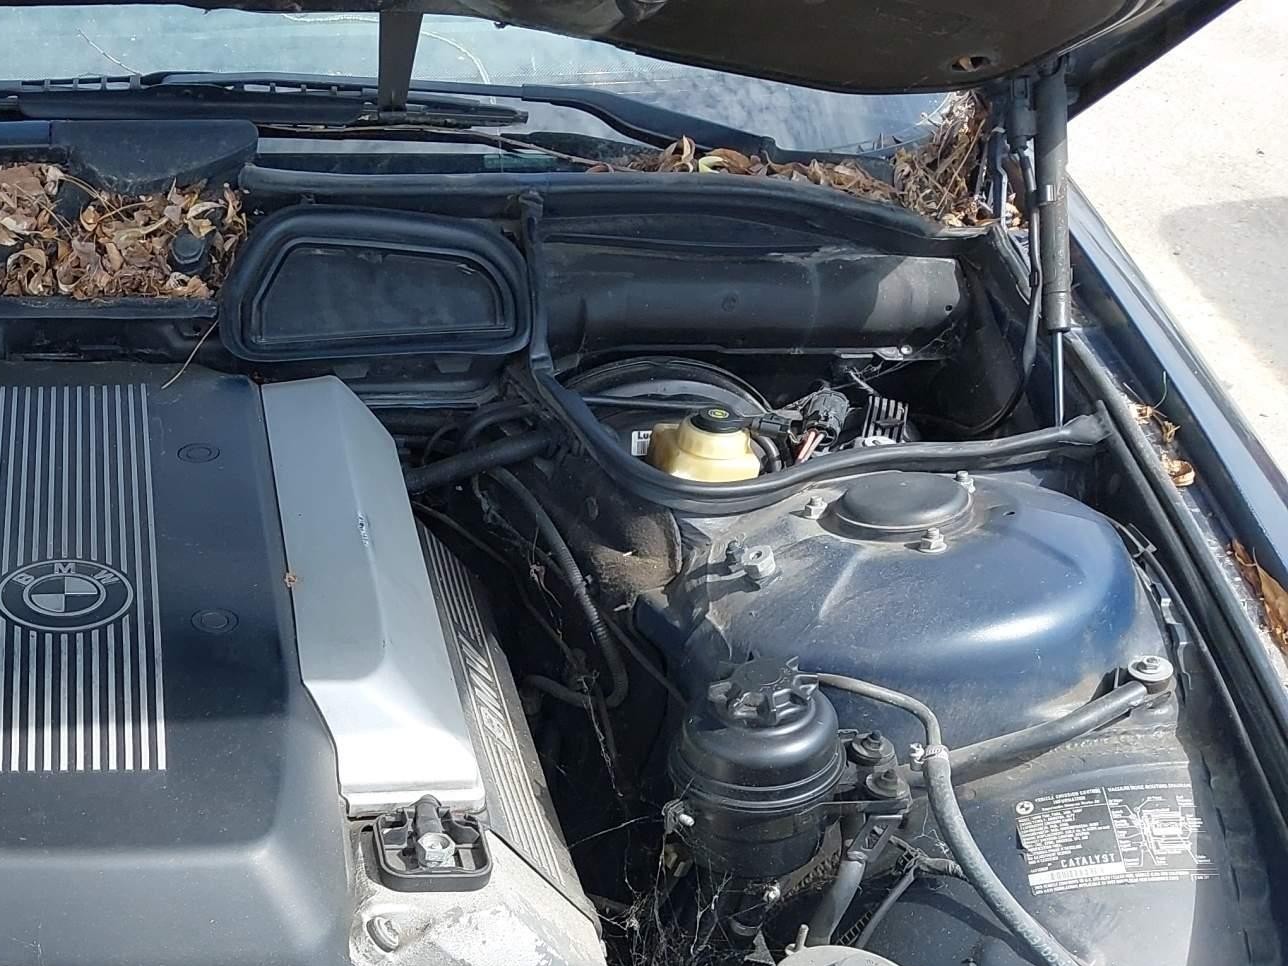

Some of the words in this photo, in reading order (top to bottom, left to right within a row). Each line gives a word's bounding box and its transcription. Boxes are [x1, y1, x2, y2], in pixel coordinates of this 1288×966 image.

[12, 563, 120, 585] BMW
[458, 631, 513, 752] BMW
[1061, 853, 1116, 868] CATALYST
